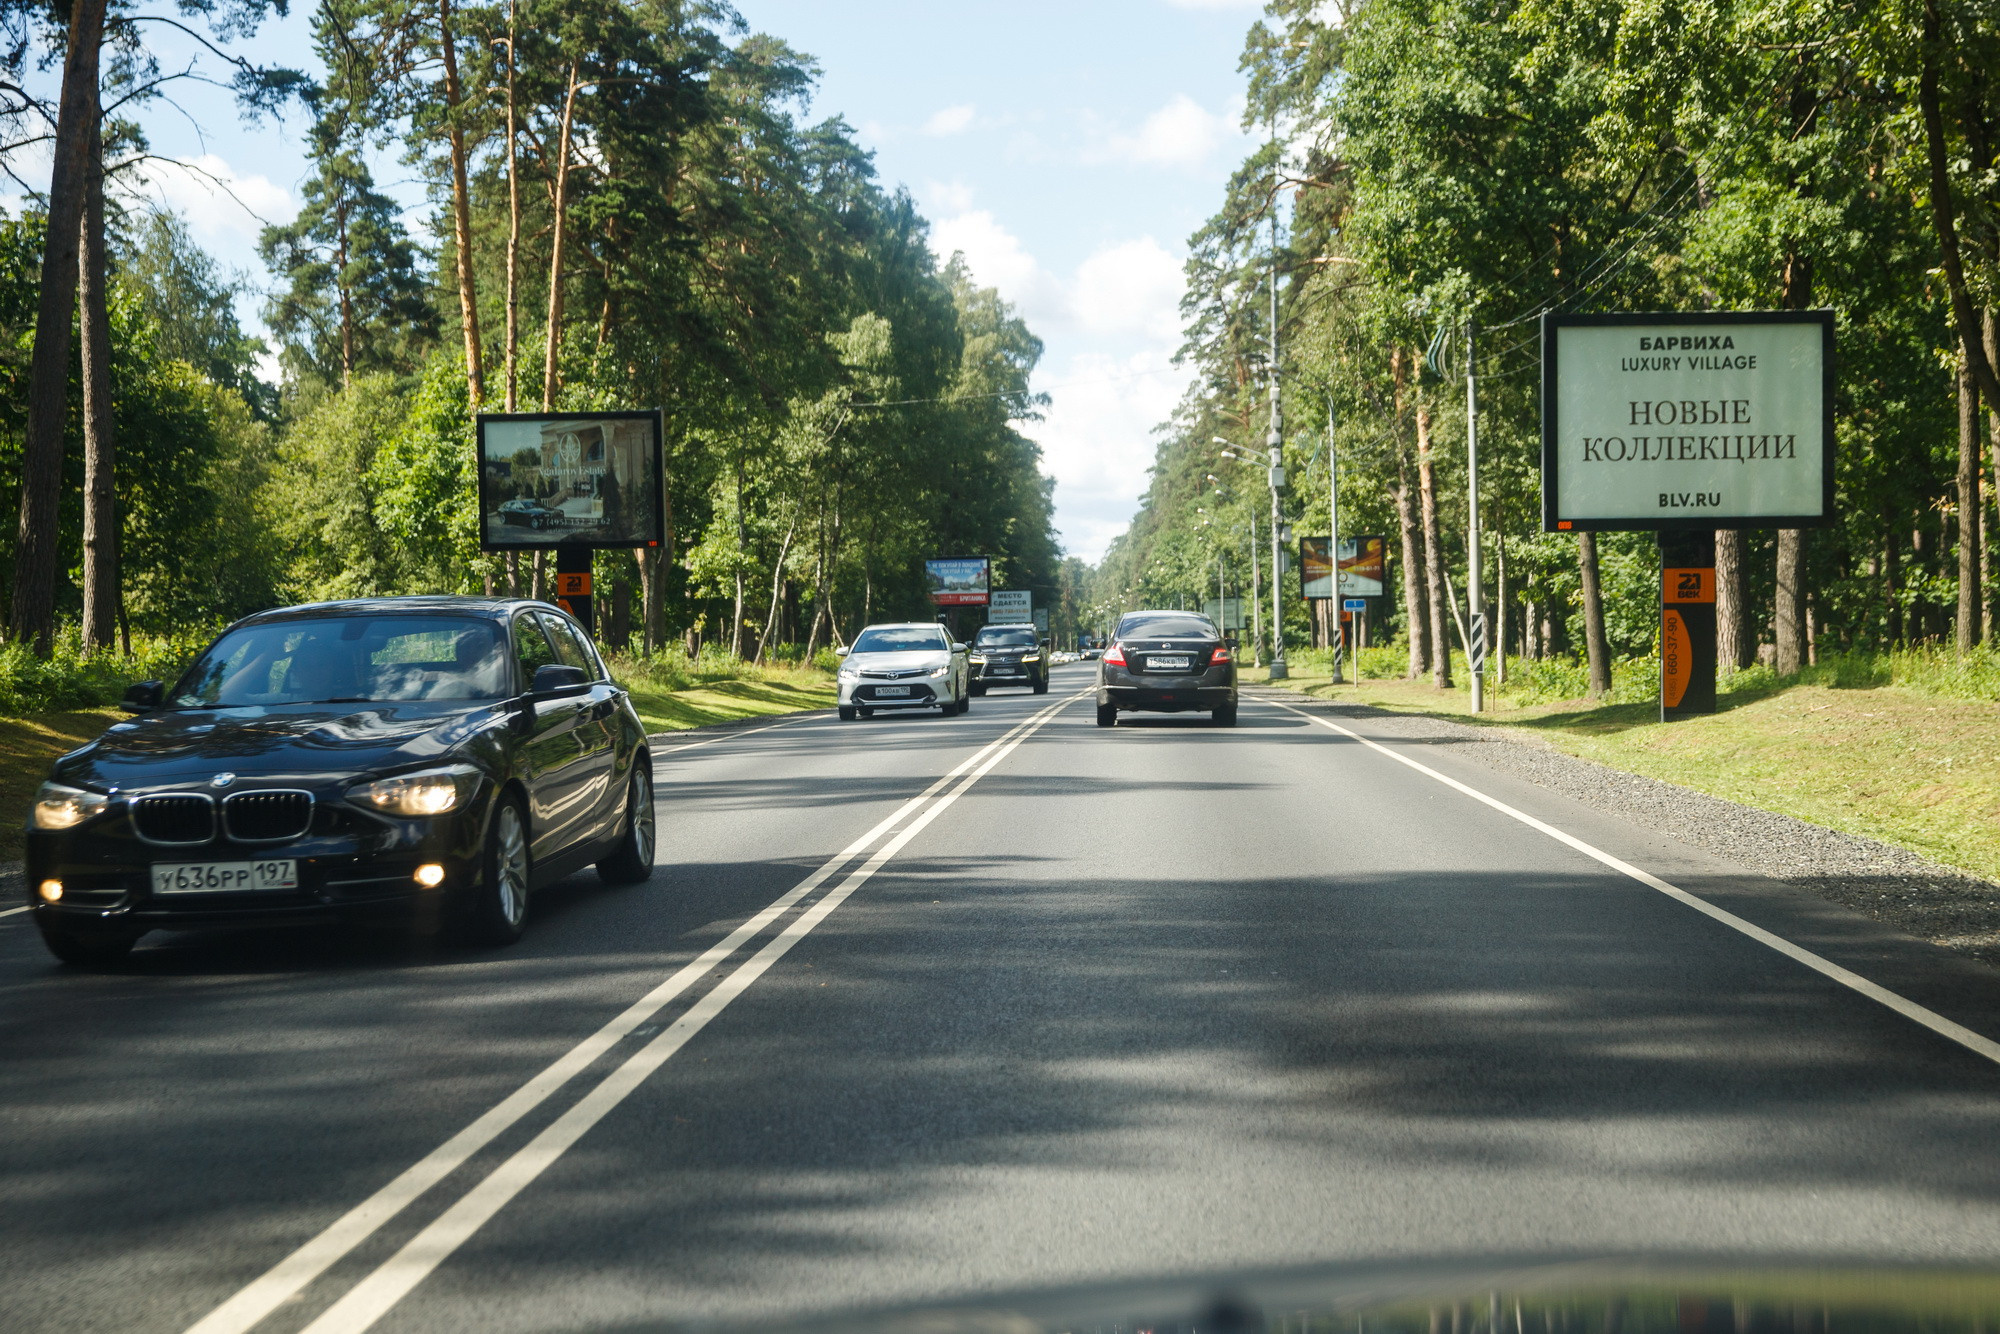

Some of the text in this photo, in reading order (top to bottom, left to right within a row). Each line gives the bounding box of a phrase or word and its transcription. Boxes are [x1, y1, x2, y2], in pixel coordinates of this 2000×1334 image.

[1640, 336, 1735, 351] БАРВИХА
[1622, 355, 1757, 372] LUXURY VILLAGE
[1628, 400, 1751, 426] НОВЫЕ
[1582, 435, 1797, 465] КОЛЛЕКЦИИ
[1659, 493, 1721, 508] BLV.RU
[1677, 573, 1701, 590] 21
[1667, 616, 1678, 675] 660-37-90
[159, 862, 290, 889] У636РР 197
